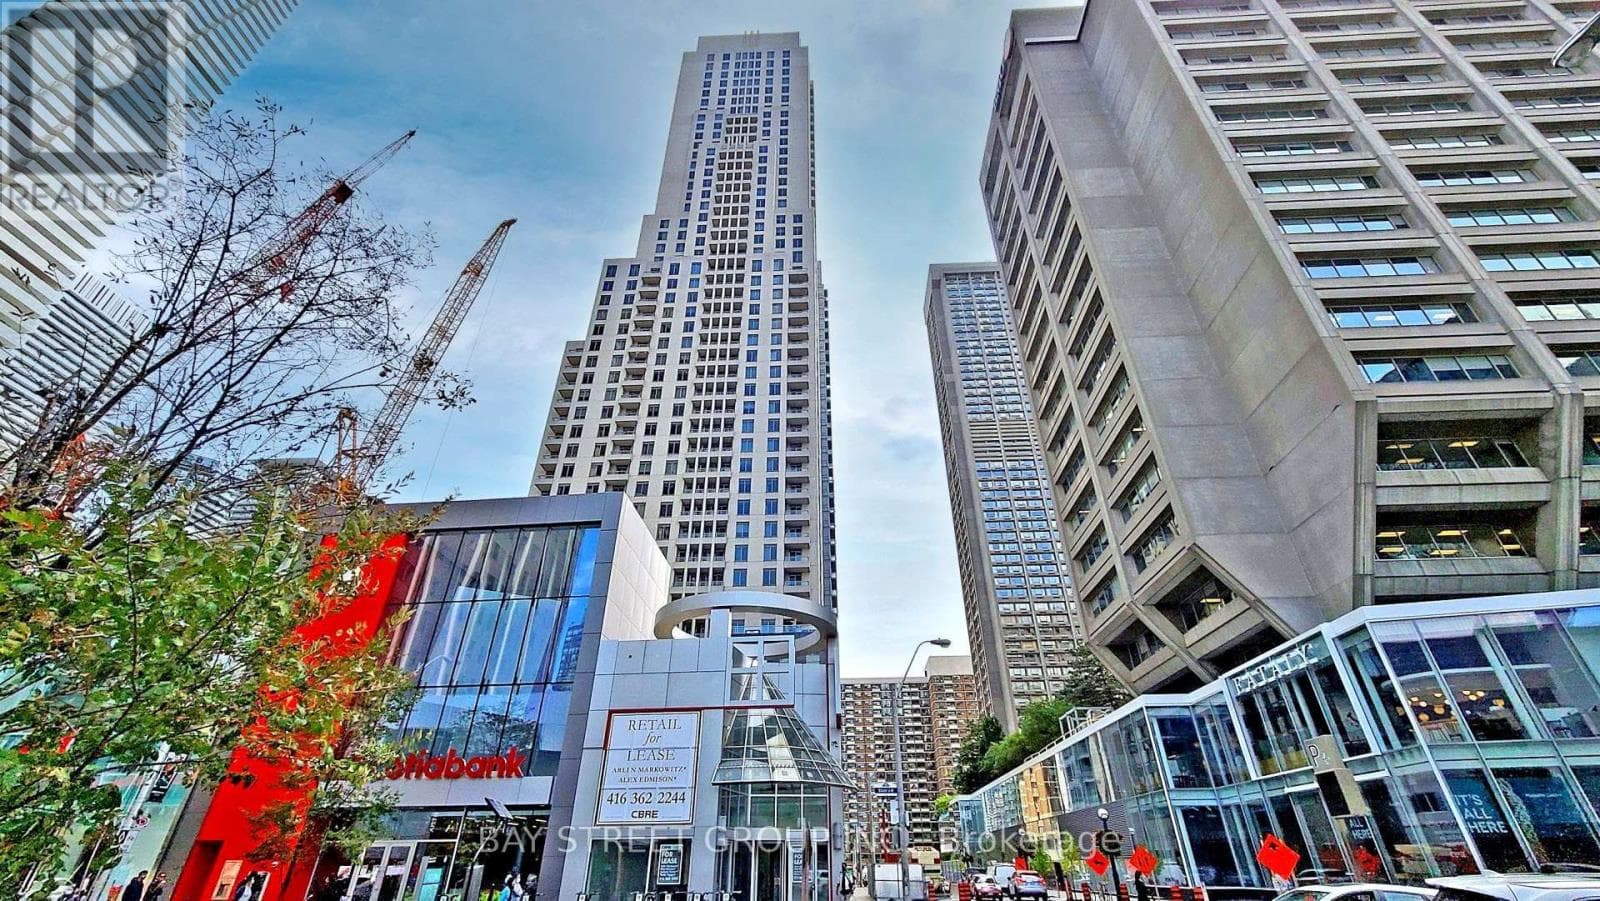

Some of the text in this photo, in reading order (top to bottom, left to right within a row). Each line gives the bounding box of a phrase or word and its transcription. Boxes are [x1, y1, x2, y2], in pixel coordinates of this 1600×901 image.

[628, 718, 682, 731] RETAIL
[642, 731, 662, 746] for
[627, 749, 676, 762] LEASE
[607, 791, 686, 805] 416 362 2244
[631, 810, 659, 819] CBRE
[1464, 809, 1492, 819] ALL
[1468, 821, 1509, 834] HERE
